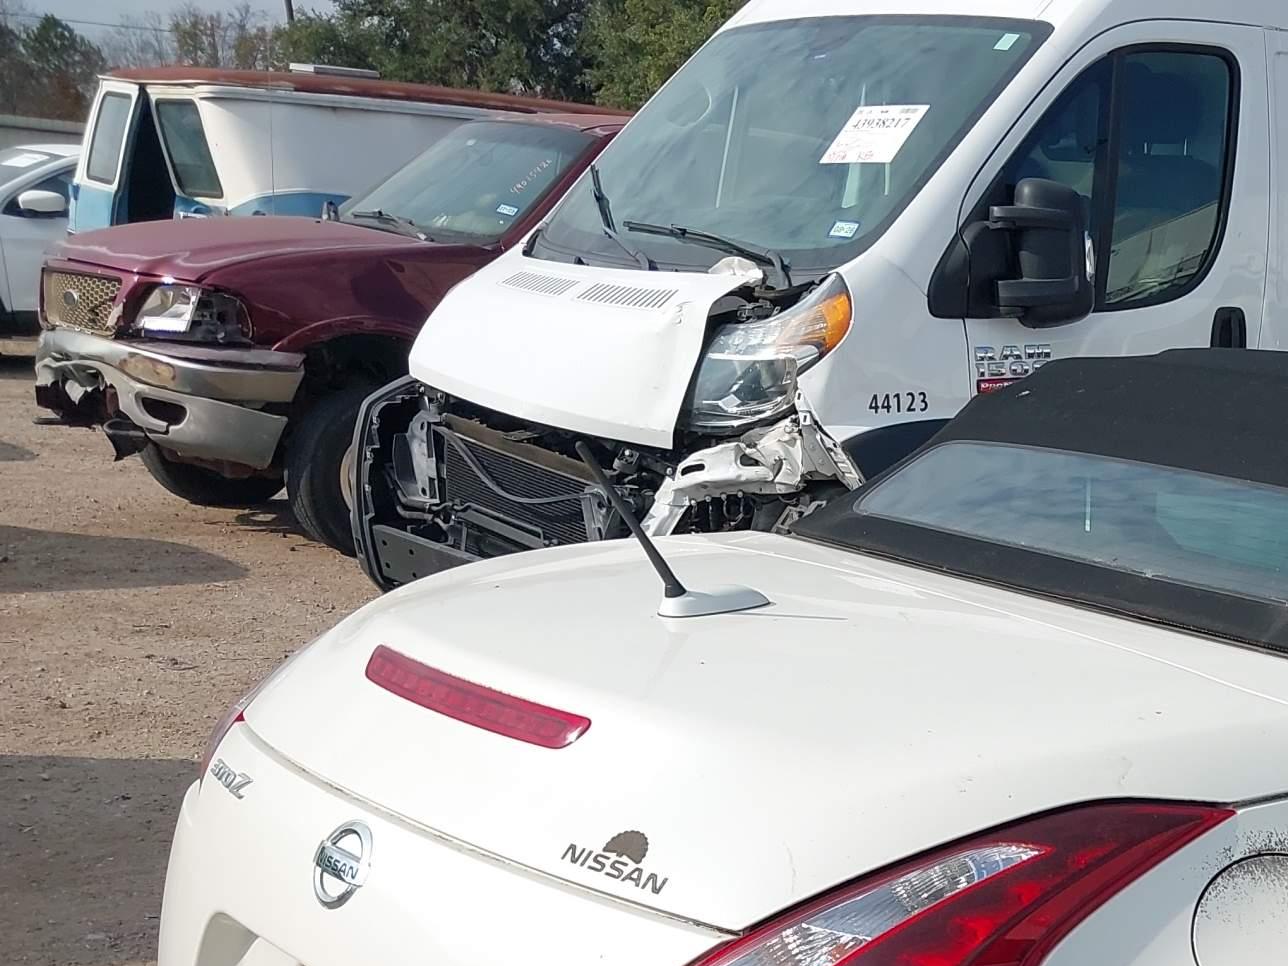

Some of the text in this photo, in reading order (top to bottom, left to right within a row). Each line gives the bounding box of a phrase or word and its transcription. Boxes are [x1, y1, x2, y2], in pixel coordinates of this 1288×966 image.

[974, 344, 1052, 362] RAM
[868, 391, 929, 414] 44123
[317, 846, 360, 881] NISSAN
[560, 843, 669, 895] NISSAN
